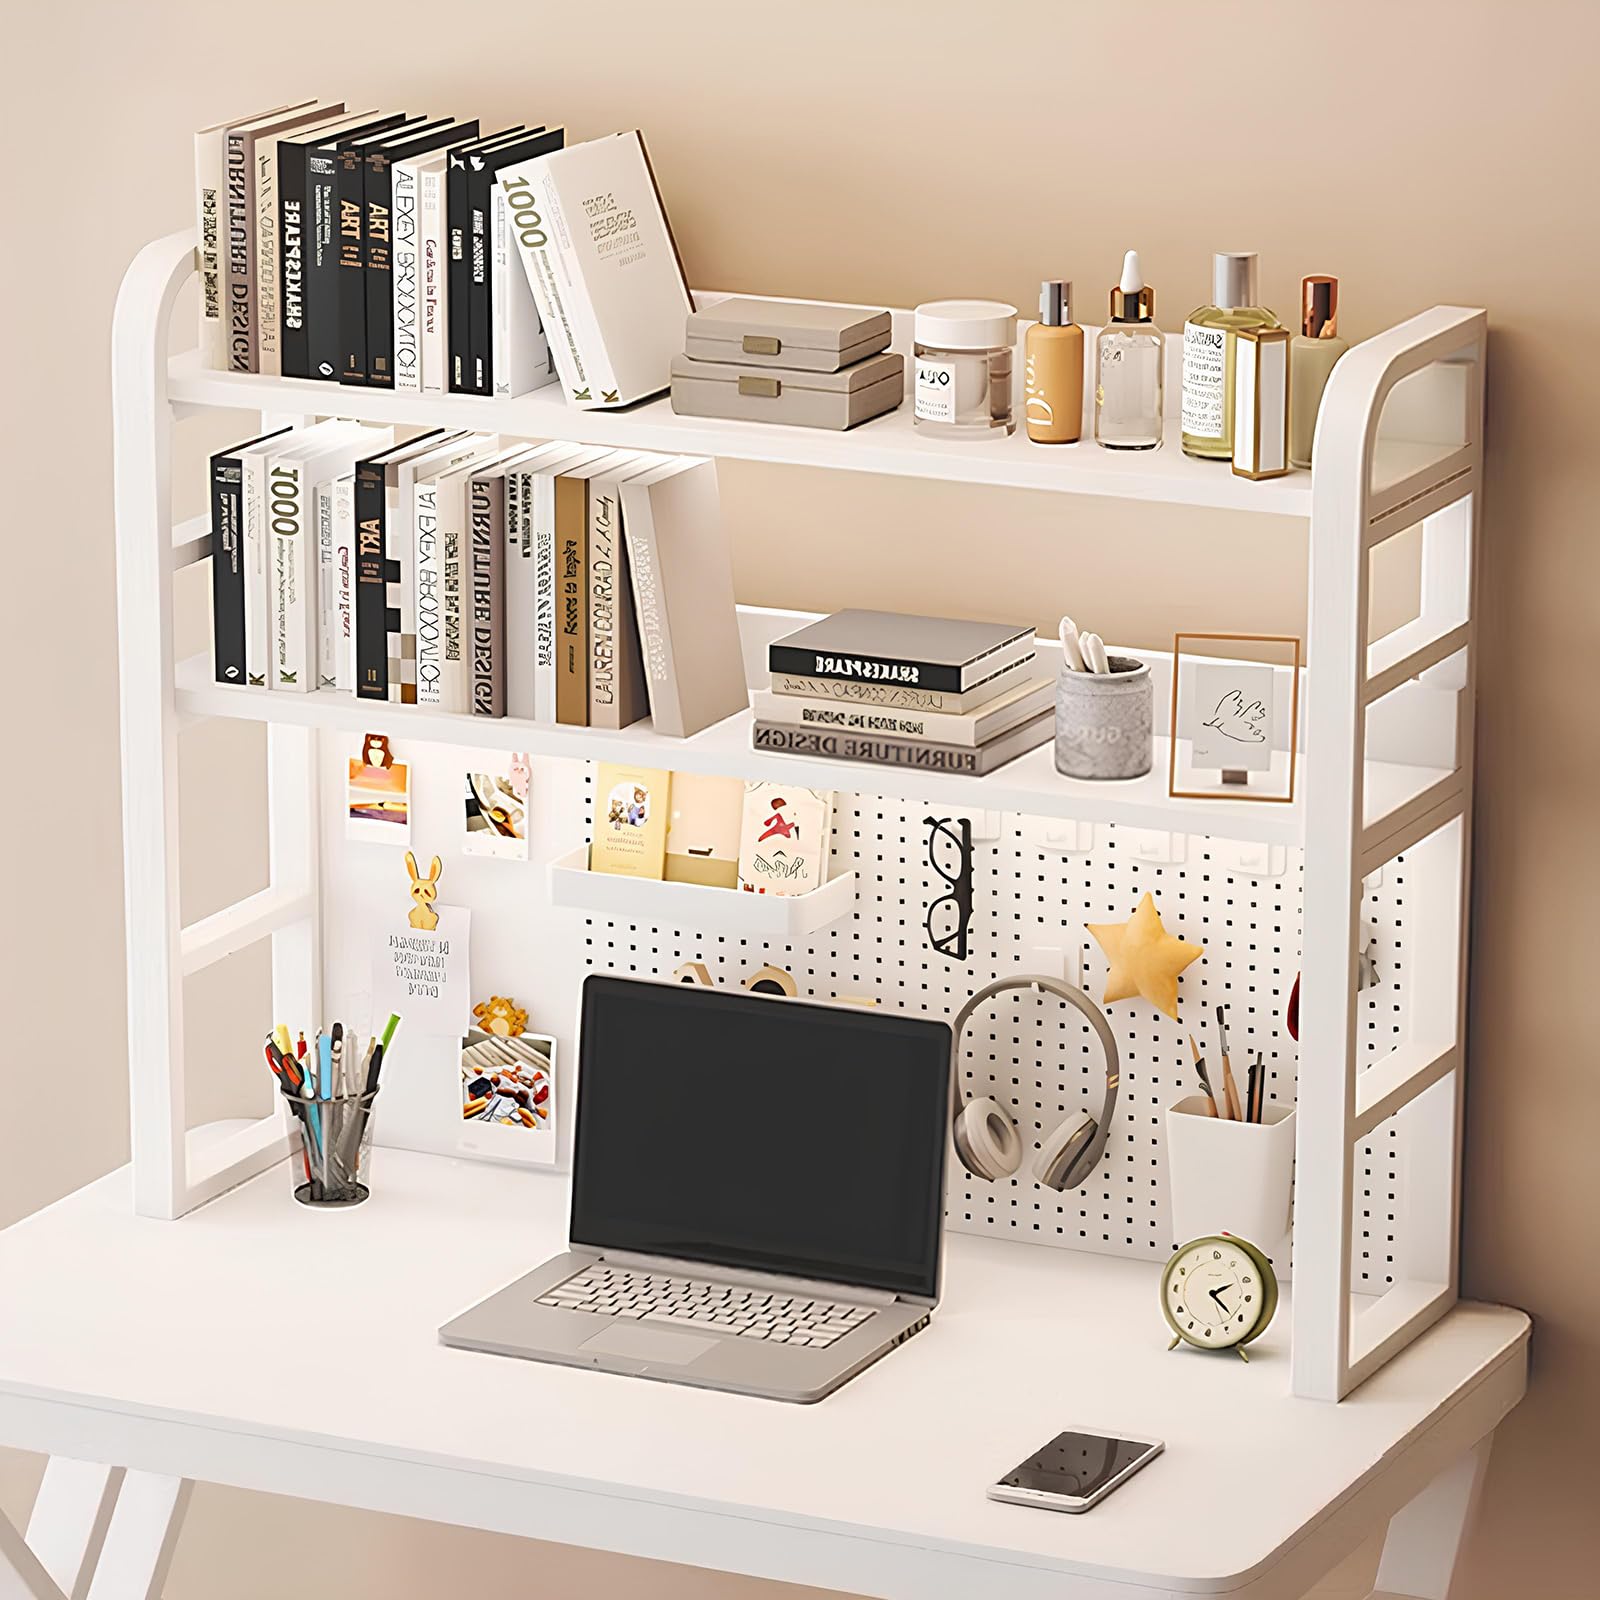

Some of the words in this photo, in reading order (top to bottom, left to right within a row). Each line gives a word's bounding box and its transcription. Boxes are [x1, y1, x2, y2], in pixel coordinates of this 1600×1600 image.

[340, 199, 363, 241] ART
[368, 201, 390, 243] ART
[502, 176, 548, 249] 1000
